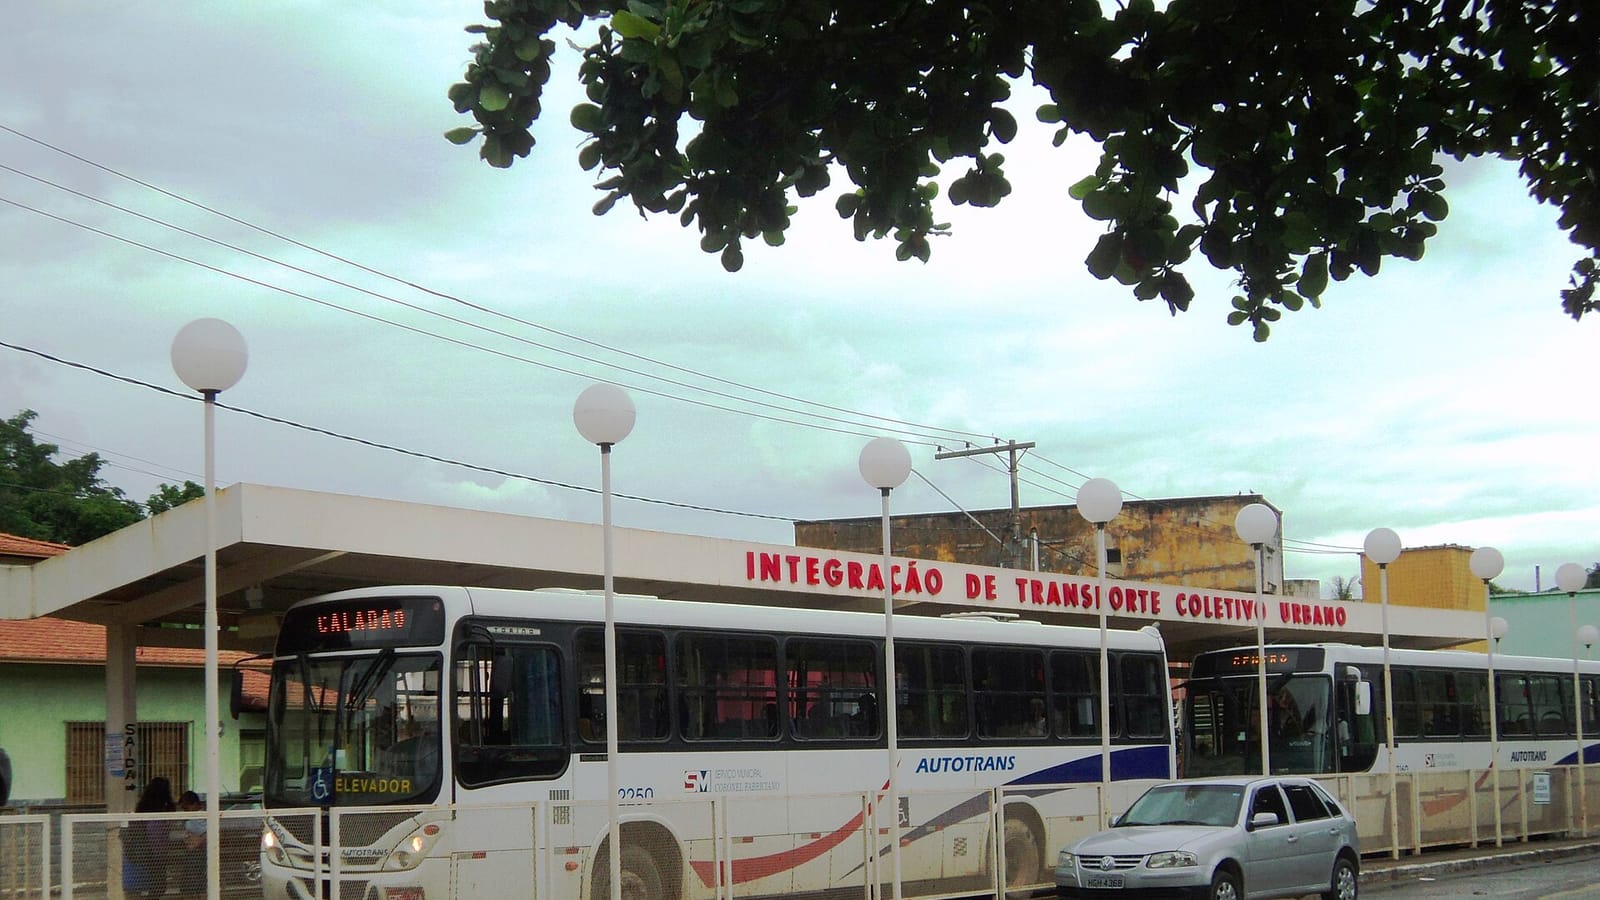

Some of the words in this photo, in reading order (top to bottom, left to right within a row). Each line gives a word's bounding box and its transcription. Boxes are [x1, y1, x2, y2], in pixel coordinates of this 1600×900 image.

[746, 551, 944, 596] INTEGRAÇÃO
[965, 573, 997, 600] DE
[1279, 602, 1347, 627] URBANO
[1510, 750, 1547, 762] AUTOTRANS
[915, 756, 1015, 773] AUTOTRANS
[335, 778, 411, 793] ELEVADOR
